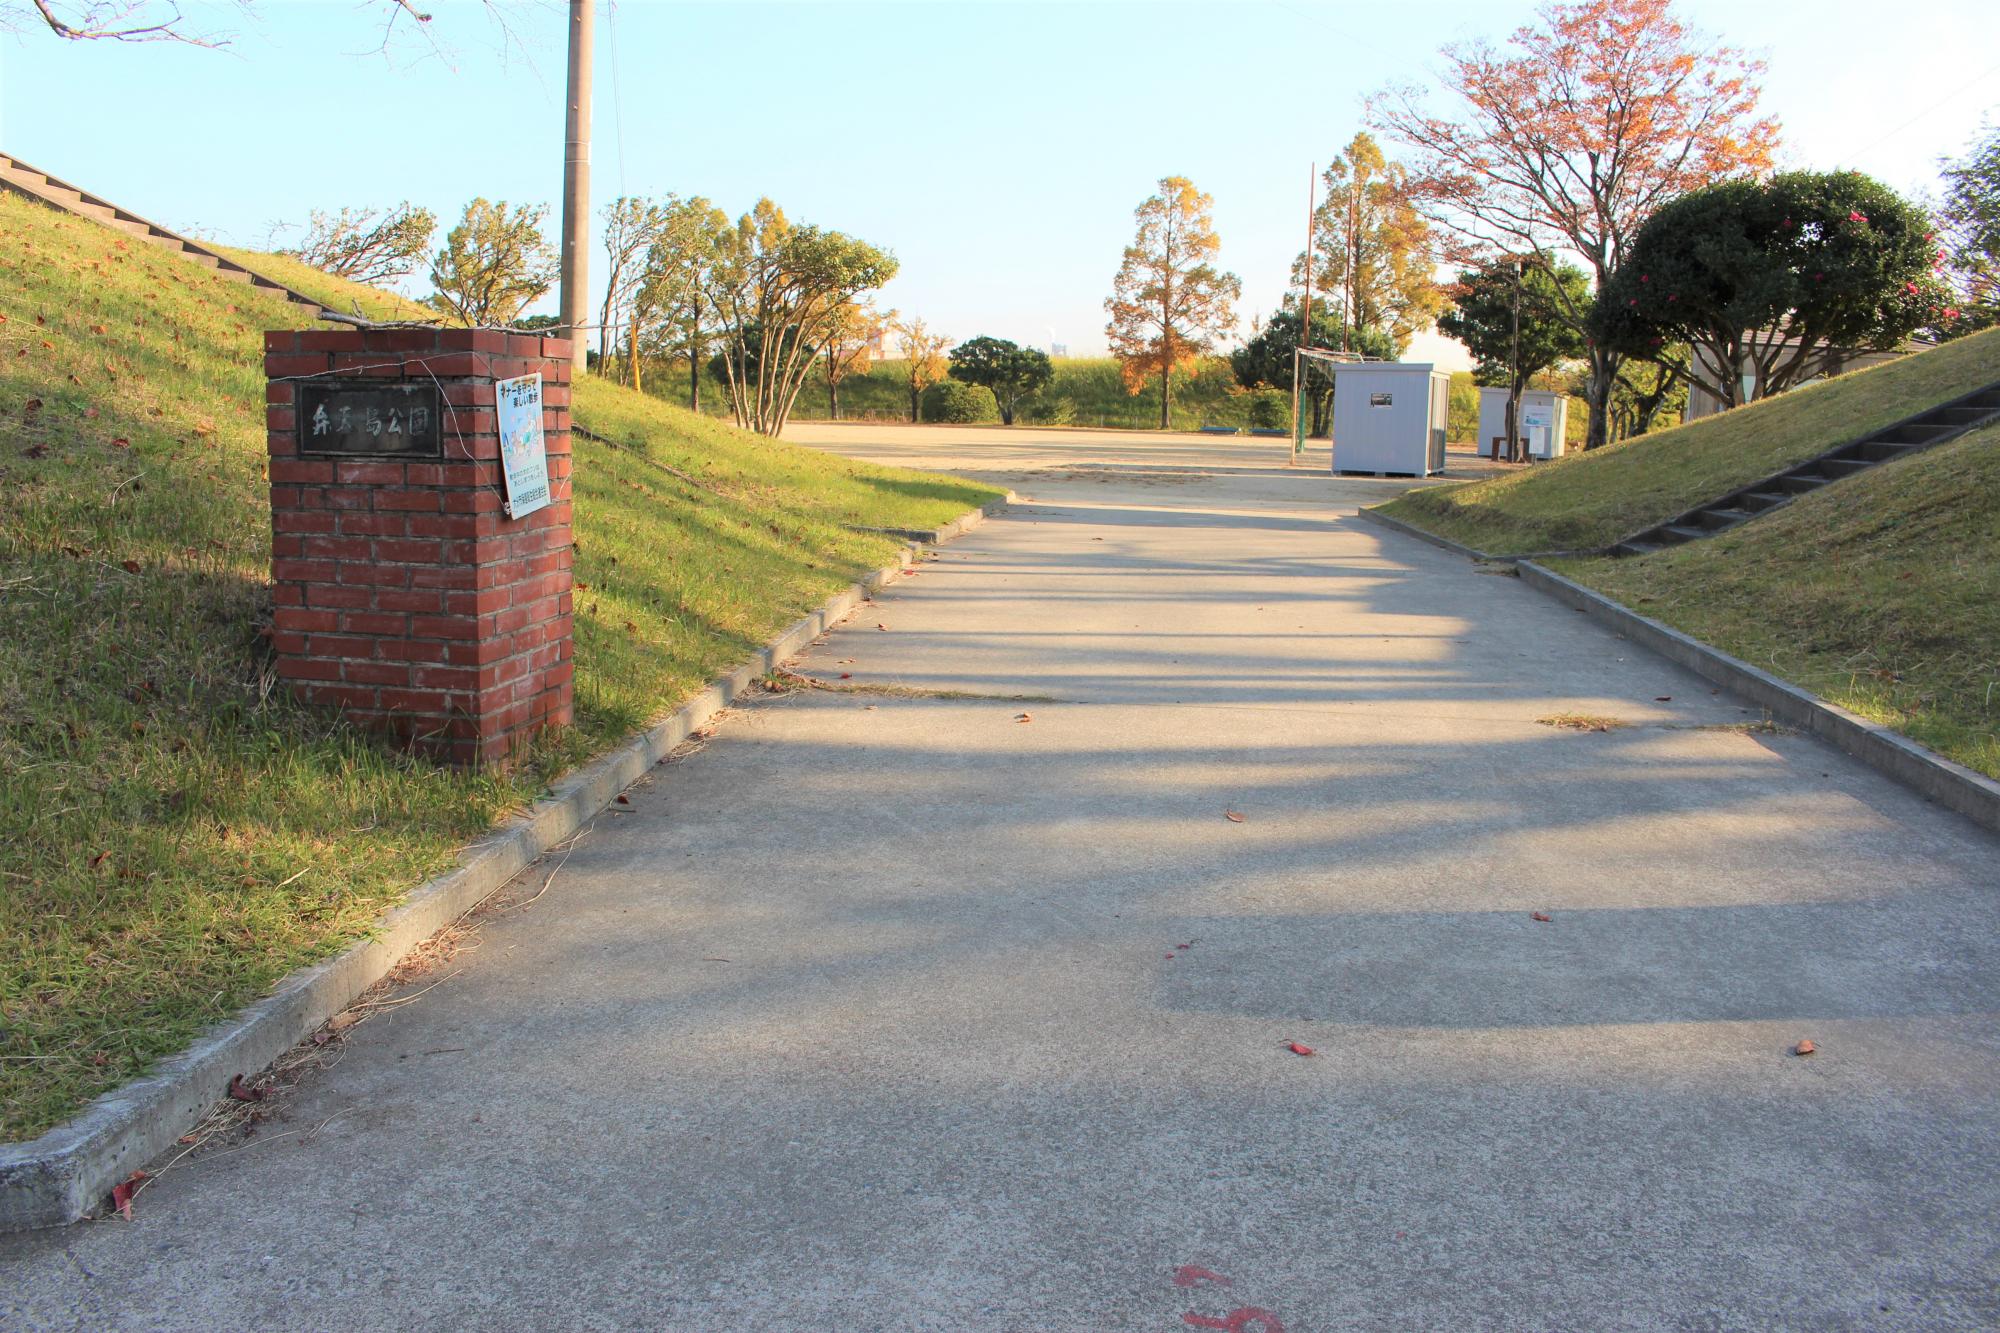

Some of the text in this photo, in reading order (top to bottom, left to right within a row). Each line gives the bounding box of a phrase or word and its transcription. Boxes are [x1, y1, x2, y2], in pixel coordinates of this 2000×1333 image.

[500, 383, 537, 399] マナーを守って
[513, 392, 539, 408] 楽しい散歩
